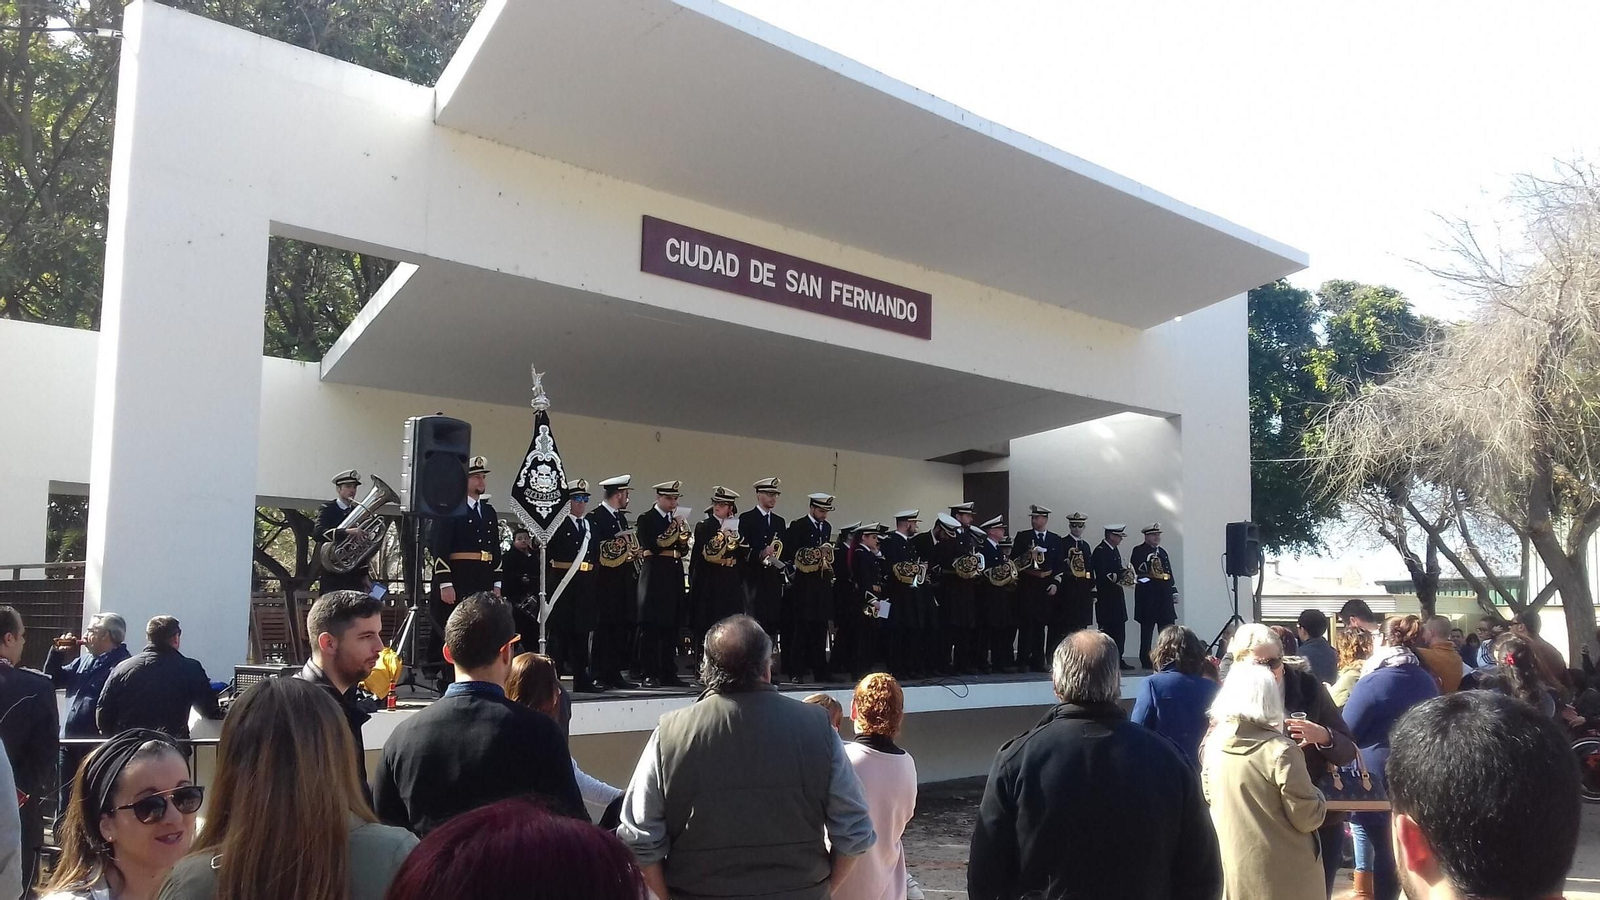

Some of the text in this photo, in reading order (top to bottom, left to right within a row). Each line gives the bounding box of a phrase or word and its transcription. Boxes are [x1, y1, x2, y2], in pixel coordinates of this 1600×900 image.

[665, 237, 918, 323] CIUDAD DE SAN FERNANDO
